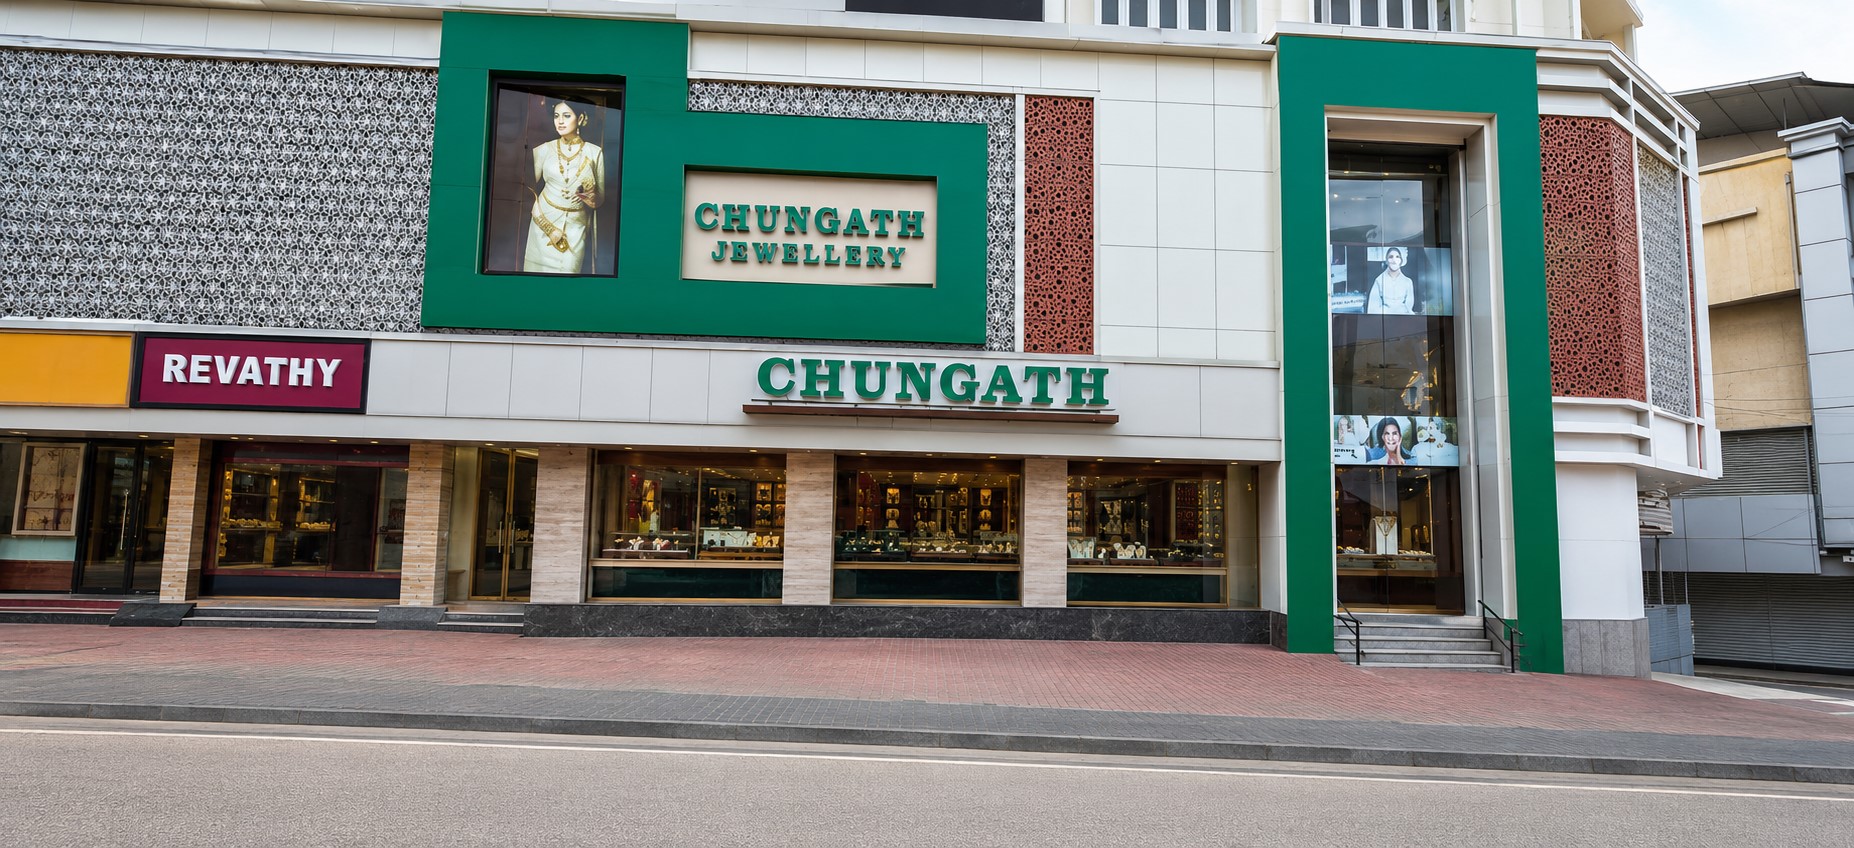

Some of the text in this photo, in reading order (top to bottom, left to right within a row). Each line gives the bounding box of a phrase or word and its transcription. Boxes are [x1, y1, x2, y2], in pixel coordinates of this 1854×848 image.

[694, 202, 925, 238] CHUNGATH
[711, 241, 906, 268] JEWELLERY
[163, 353, 342, 387] REVATHY
[757, 357, 1109, 405] CHUNGATH
